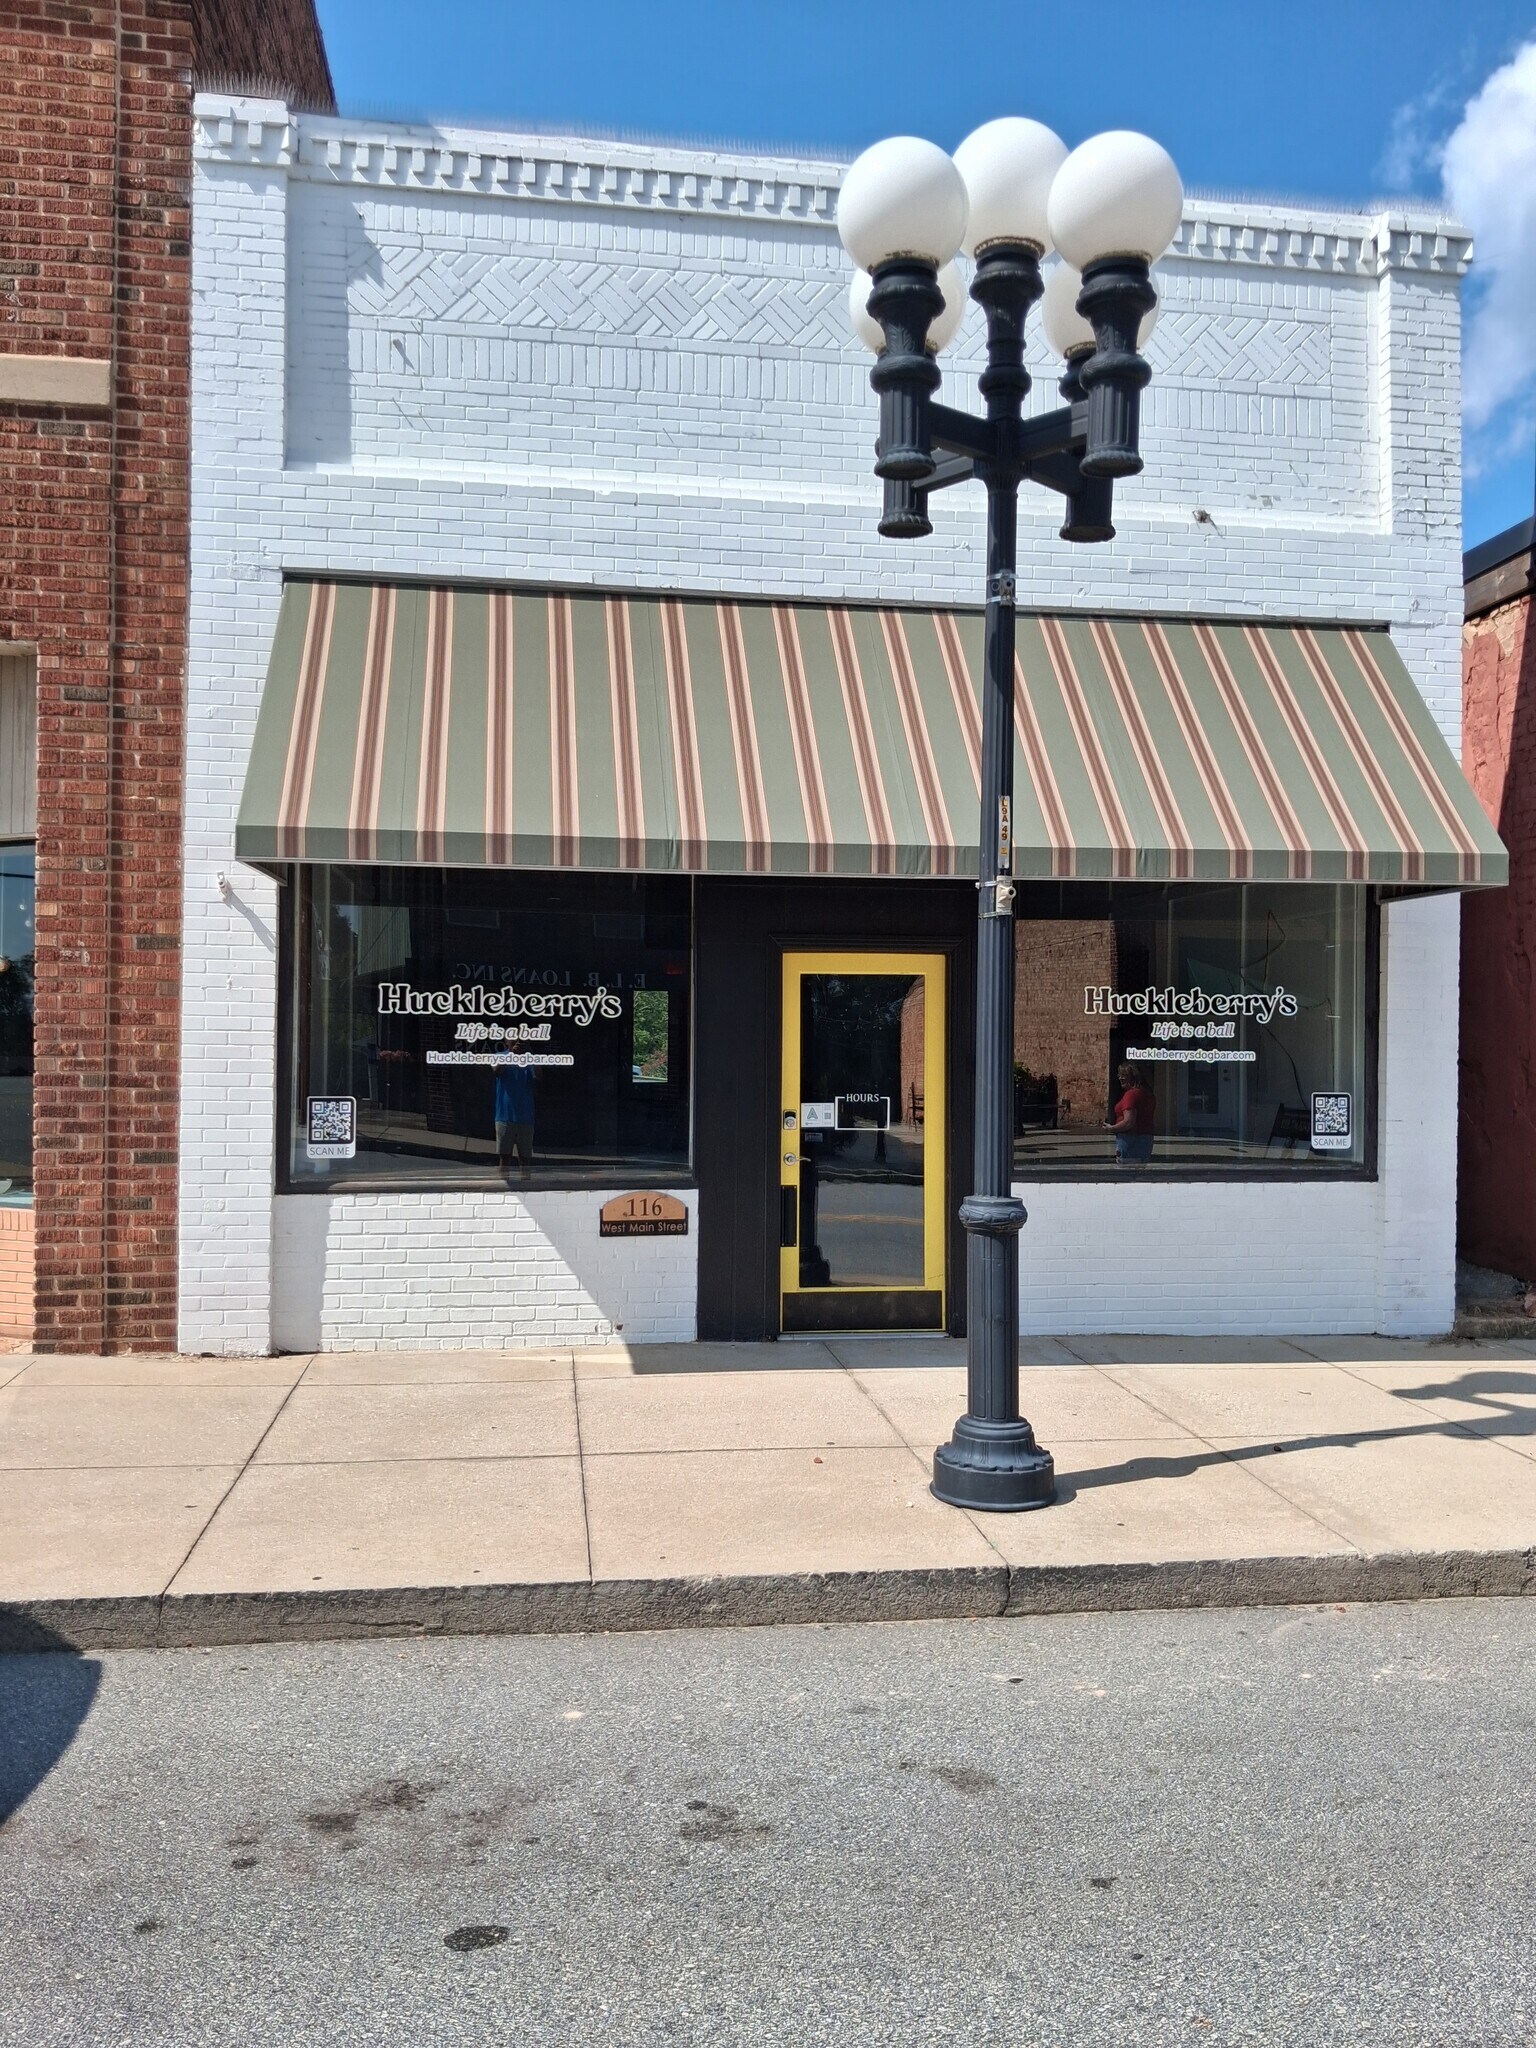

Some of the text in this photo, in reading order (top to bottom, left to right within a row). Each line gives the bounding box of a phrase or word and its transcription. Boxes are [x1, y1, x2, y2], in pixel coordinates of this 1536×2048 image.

[378, 982, 622, 1026] Huckleberry's
[1084, 986, 1298, 1024] Huckleberry's
[455, 1023, 551, 1042] Life is a ball
[1151, 1022, 1235, 1040] Life is a ball
[427, 1052, 574, 1066] Huckleberrysdogbar.com
[1127, 1048, 1256, 1063] Huckleberrysdogbar.com
[846, 1093, 880, 1102] HOURS
[807, 1107, 819, 1120] A
[1313, 1138, 1347, 1146] SCAN ME
[310, 1147, 350, 1155] SCAN ME
[627, 1197, 662, 1216] 116
[601, 1221, 687, 1233] West Main Street
